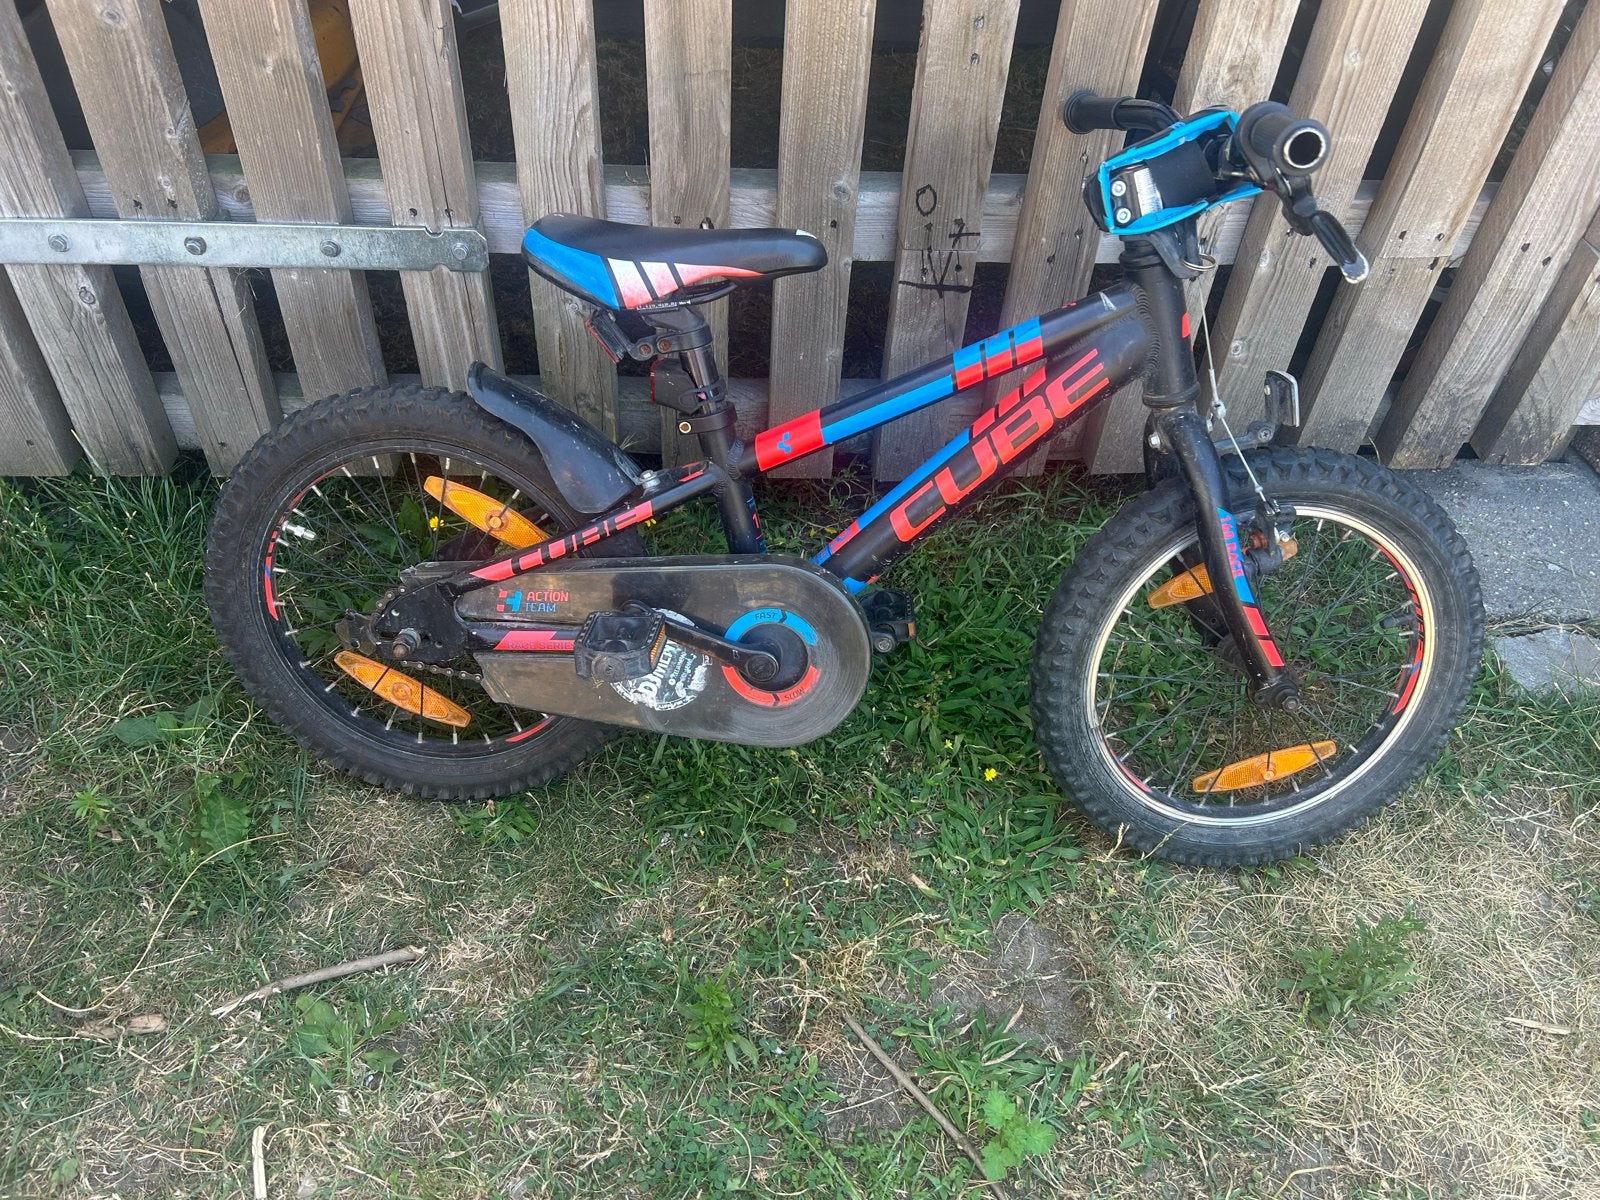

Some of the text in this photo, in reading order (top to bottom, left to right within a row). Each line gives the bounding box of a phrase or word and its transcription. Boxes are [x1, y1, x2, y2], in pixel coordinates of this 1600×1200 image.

[889, 348, 1110, 543] CUBE
[526, 591, 569, 602] ACTION
[525, 602, 556, 613] TEAM
[754, 611, 778, 621] FAST
[507, 641, 536, 650] RACE
[784, 686, 805, 701] SLOW
